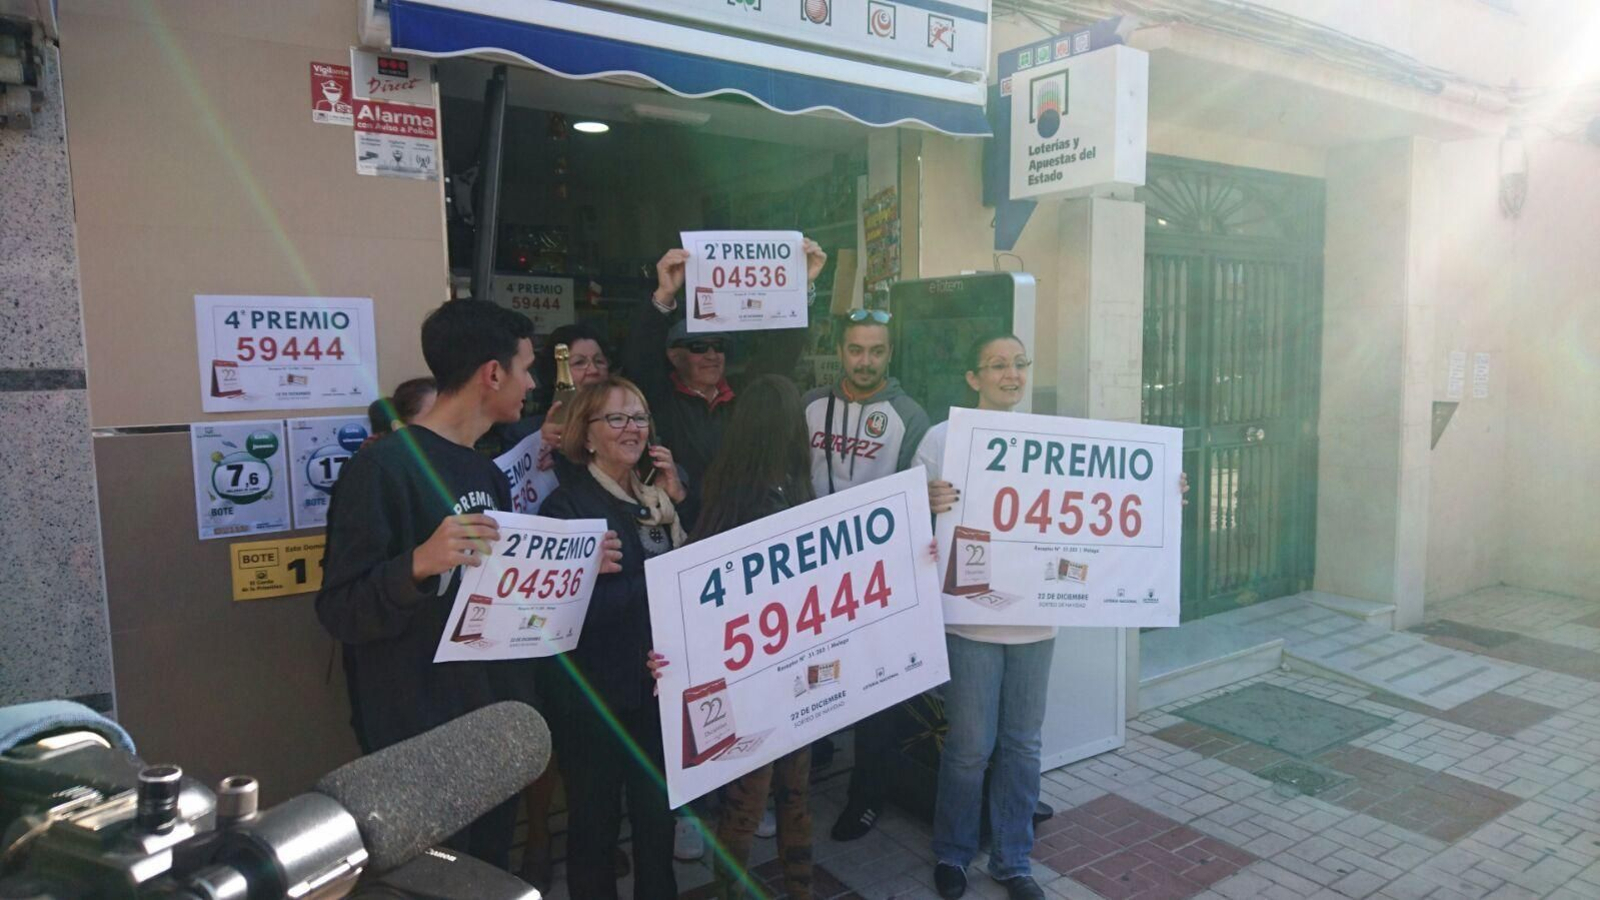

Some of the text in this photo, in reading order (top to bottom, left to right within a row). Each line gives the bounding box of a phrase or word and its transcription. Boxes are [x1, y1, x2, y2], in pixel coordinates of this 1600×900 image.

[357, 104, 434, 128] Alarma
[357, 121, 374, 129] con
[375, 123, 398, 132] Aviso
[1028, 137, 1080, 156] Loterías y
[1028, 147, 1096, 172] Apuestas del
[1028, 169, 1063, 186] Estado
[722, 243, 791, 259] PREMIO
[518, 283, 563, 295] PREMIO
[712, 266, 787, 288] 04536
[511, 296, 561, 310] 59444
[251, 310, 350, 330] PREMIO
[236, 336, 345, 361] 59444
[504, 453, 531, 488] EMIO
[985, 436, 1154, 481] 2º PREMIO
[226, 464, 259, 488] 7,6
[305, 498, 327, 507] BOTE
[453, 490, 498, 515] PREMI
[513, 479, 539, 512] 536
[211, 507, 234, 517] BOTE
[992, 486, 1143, 538] 04536
[242, 553, 275, 564] BOTE
[526, 535, 596, 561] PREMIO
[700, 507, 895, 608] 4º PREMIO
[965, 544, 986, 566] 22
[496, 567, 584, 600] 04536
[1047, 592, 1055, 600] DE
[1056, 592, 1089, 601] DICIEMBRE
[470, 606, 486, 621] 22
[723, 559, 892, 672] 59444
[700, 697, 727, 728] 22
[790, 690, 847, 721] 22 DE DICIEMBRE
